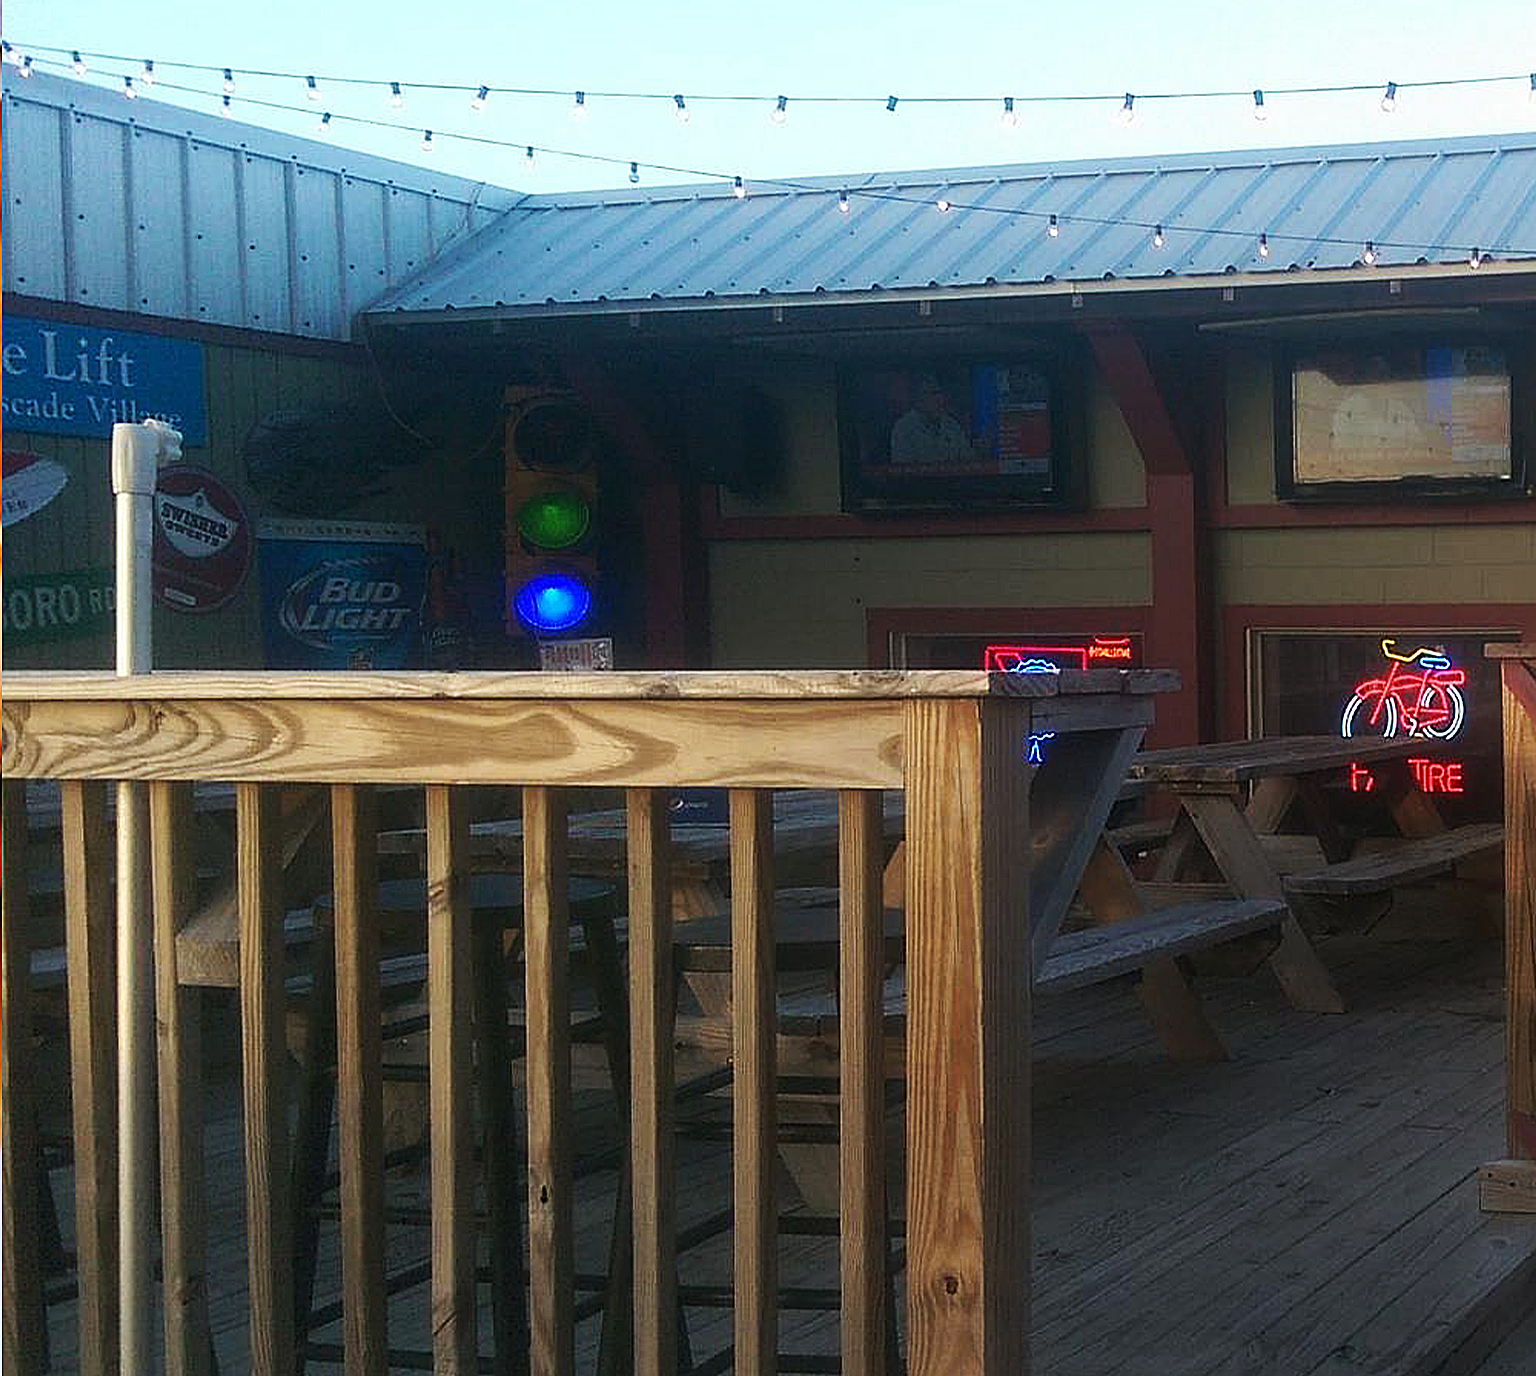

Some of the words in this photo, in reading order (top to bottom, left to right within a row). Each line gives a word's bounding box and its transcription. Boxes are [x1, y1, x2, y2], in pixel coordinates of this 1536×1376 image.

[38, 330, 137, 387] Lift
[319, 577, 402, 604] BUD
[301, 604, 412, 631] LIGHT
[1407, 758, 1464, 794] TIRE
